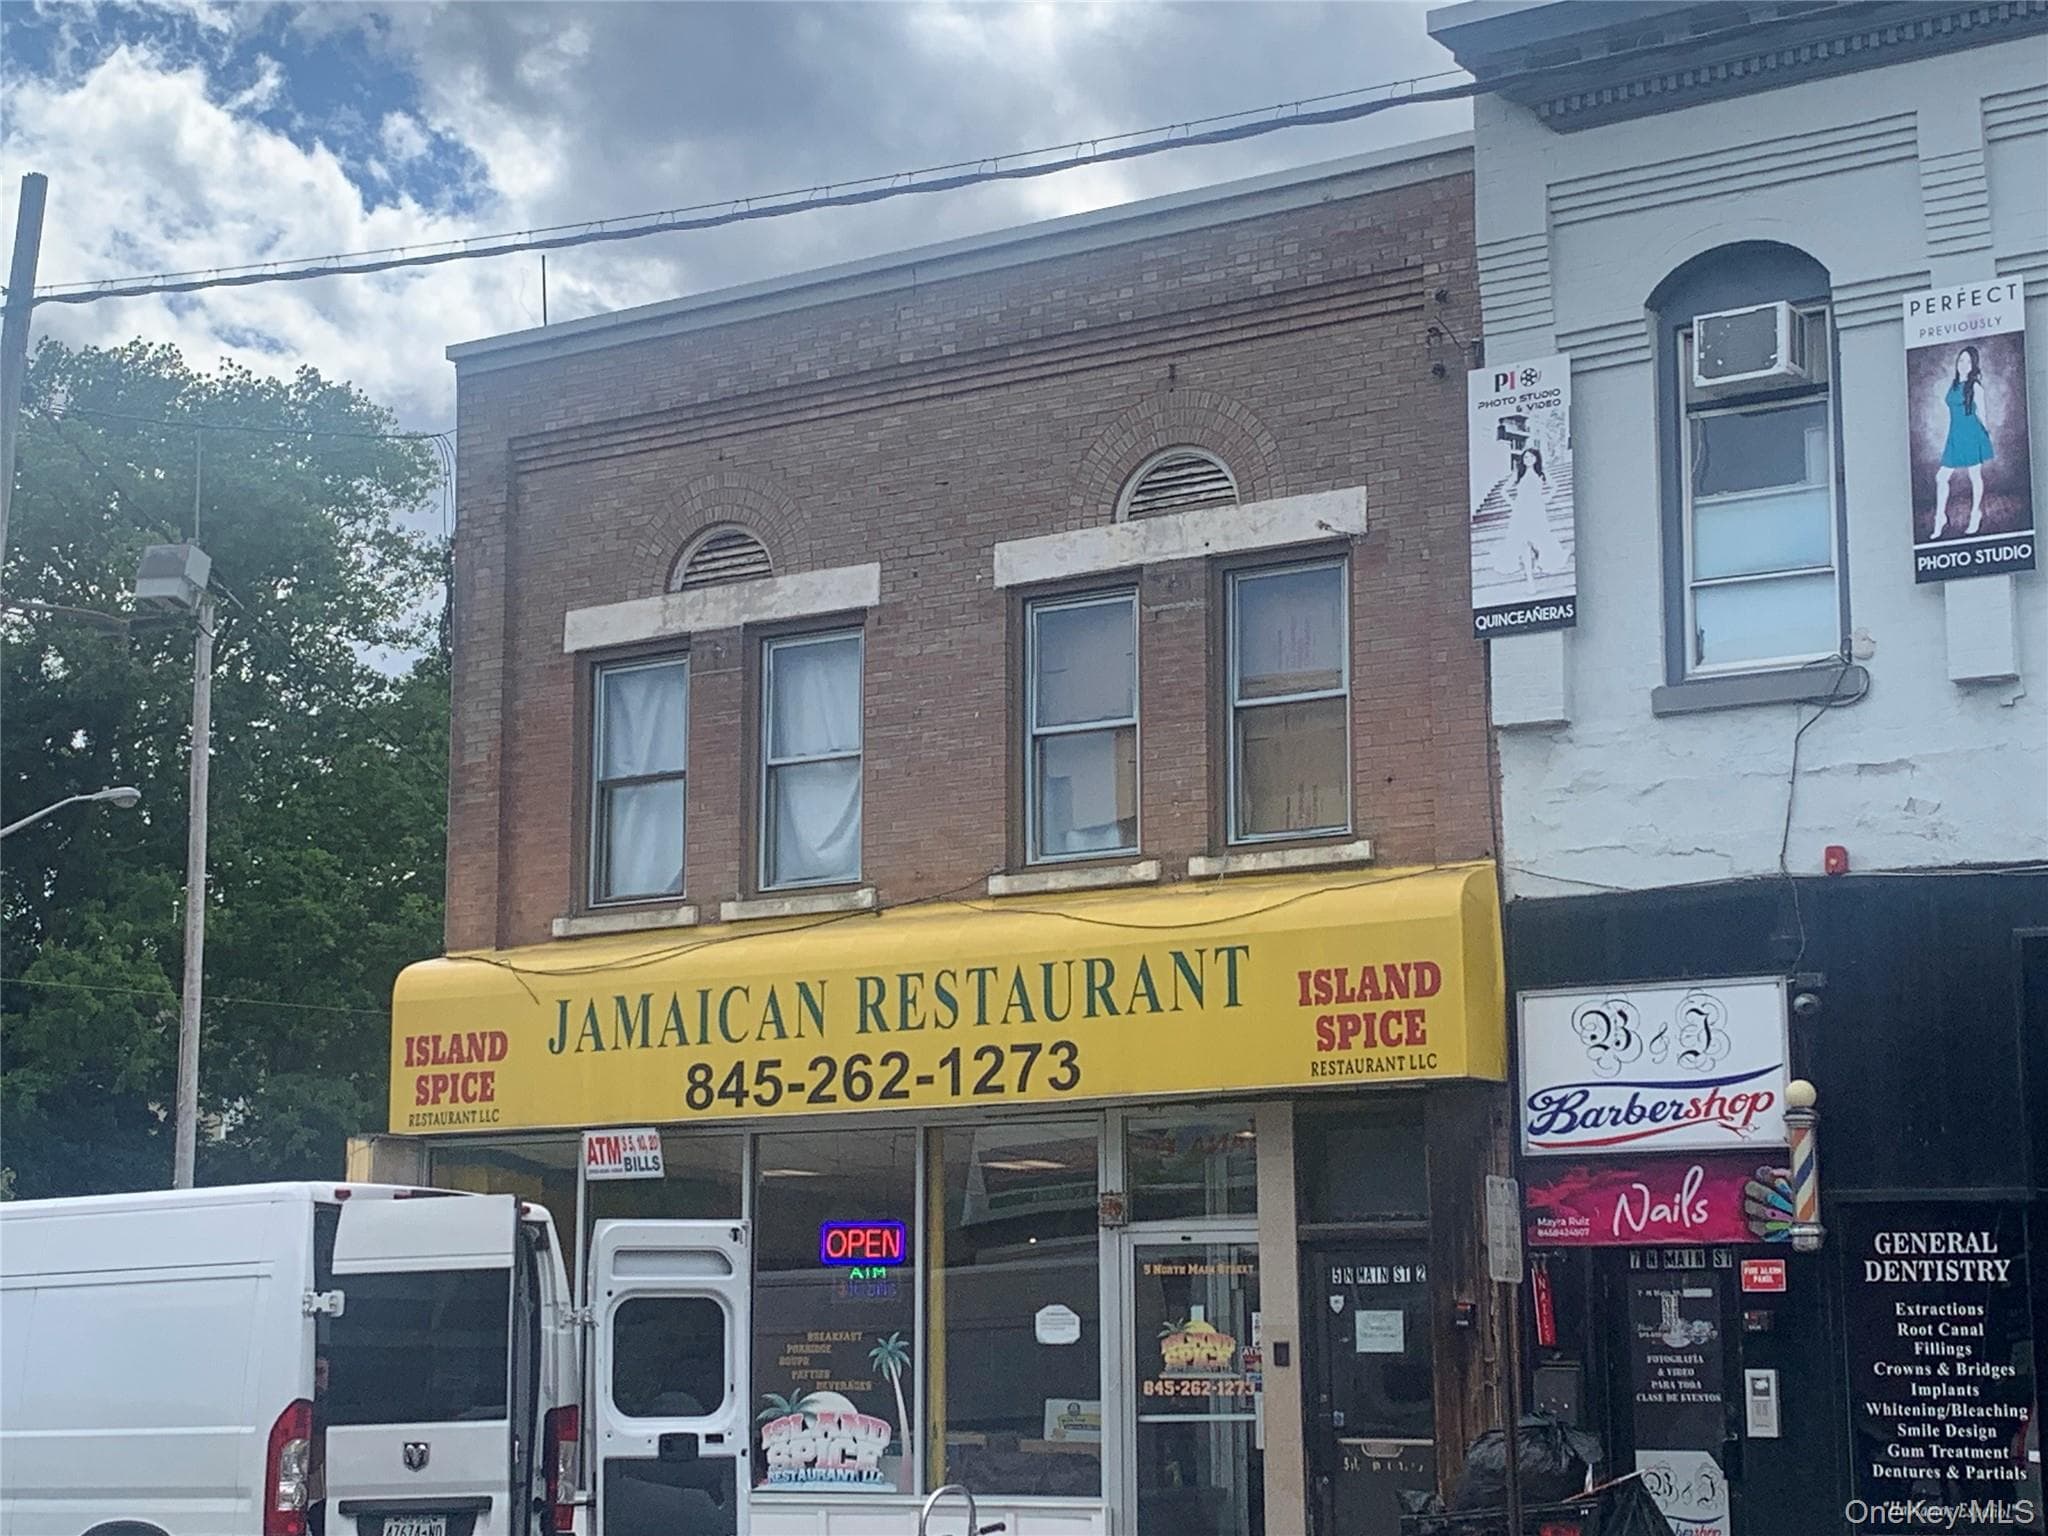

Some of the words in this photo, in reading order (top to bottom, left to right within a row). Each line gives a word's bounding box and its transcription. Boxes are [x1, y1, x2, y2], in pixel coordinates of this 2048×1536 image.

[1910, 283, 2017, 316] PERFECT
[1919, 316, 2002, 338] PREVIOUSLY
[1478, 397, 1517, 410] PHOTO
[1519, 388, 1561, 402] STUDIO
[1527, 398, 1561, 412] VIDEO
[1917, 551, 1972, 572] PHOTO
[1975, 544, 2032, 565] STUDIO
[1475, 603, 1574, 630] QUINCEAÑERAS
[1298, 960, 1442, 1006] ISLAND
[548, 979, 827, 1055] JAMAICAN
[855, 945, 1250, 1036] RESTAURANT
[1316, 1009, 1427, 1052] SPICE
[404, 1030, 508, 1067] ISLAND
[686, 1040, 1081, 1110] 845-262-1273
[1310, 1056, 1405, 1077] RESTAURANT
[1408, 1053, 1438, 1069] LLC
[415, 1071, 495, 1105] SPICE
[408, 1110, 478, 1127] RESTAURANT
[479, 1108, 500, 1122] LLC
[1528, 1087, 1774, 1135] Barbershop
[588, 1136, 622, 1166] ATM
[624, 1155, 661, 1172] BILLS
[1613, 1165, 1709, 1236] Nails
[826, 1229, 900, 1258] OPEN
[1874, 1232, 1998, 1255] GENERAL
[1664, 1250, 1705, 1268] MAIN
[1713, 1249, 1733, 1268] ST
[1356, 1266, 1388, 1284] MAIN
[1864, 1259, 2010, 1282] DENTISTRY
[1895, 1303, 1984, 1316] Extractions
[1898, 1323, 1933, 1336] Root
[1938, 1323, 1984, 1336] Canal
[1914, 1342, 1972, 1358] Fillings
[1873, 1362, 1932, 1376] Crowns
[1937, 1362, 1950, 1375] &
[1956, 1362, 2016, 1379] Bridges
[1911, 1383, 1980, 1399] Implants
[1866, 1402, 2028, 1420] Whitening/Bleaching
[1897, 1423, 1940, 1438] Smile
[1946, 1424, 1997, 1440] Design
[1887, 1444, 1924, 1458] Gum
[1929, 1444, 2009, 1459] Treatment
[768, 1468, 859, 1482] RESTAURANT
[1872, 1464, 1941, 1479] Dentures
[1946, 1464, 1960, 1479] &
[1966, 1465, 2027, 1480] Partials
